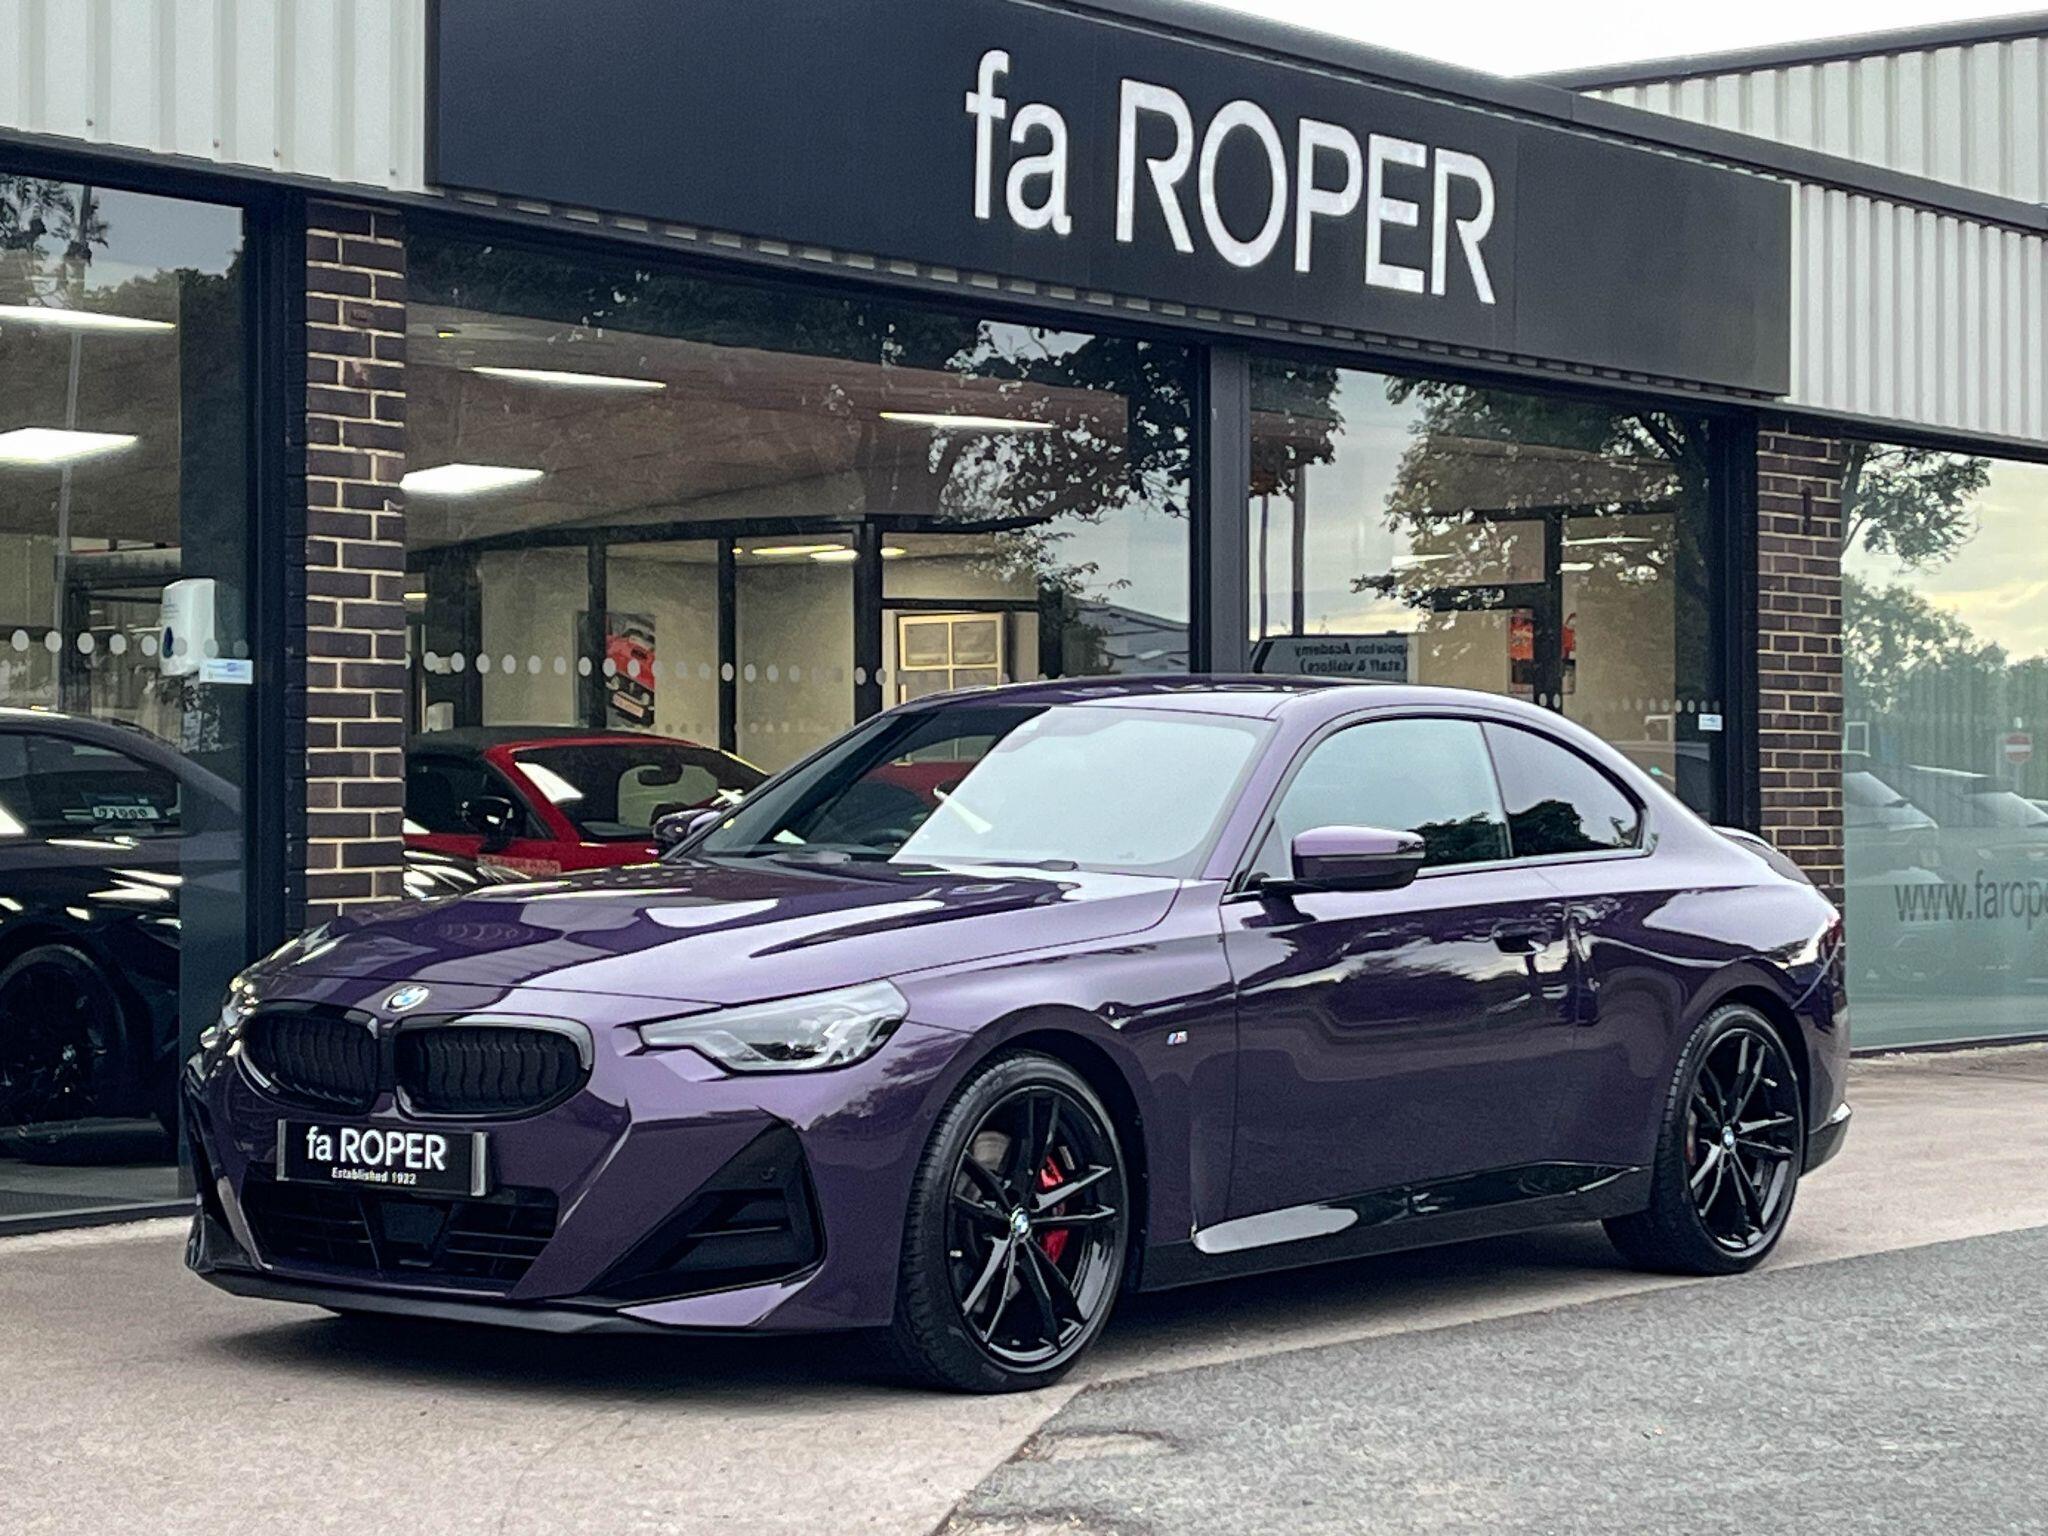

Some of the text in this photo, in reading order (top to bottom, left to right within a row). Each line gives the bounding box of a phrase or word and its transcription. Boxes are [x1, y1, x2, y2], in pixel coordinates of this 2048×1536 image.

[966, 49, 1497, 305] fa ROPER
[1894, 868, 2048, 932] www.farop
[305, 1125, 447, 1171] fa ROPER
[331, 1166, 417, 1185] Established 1922
